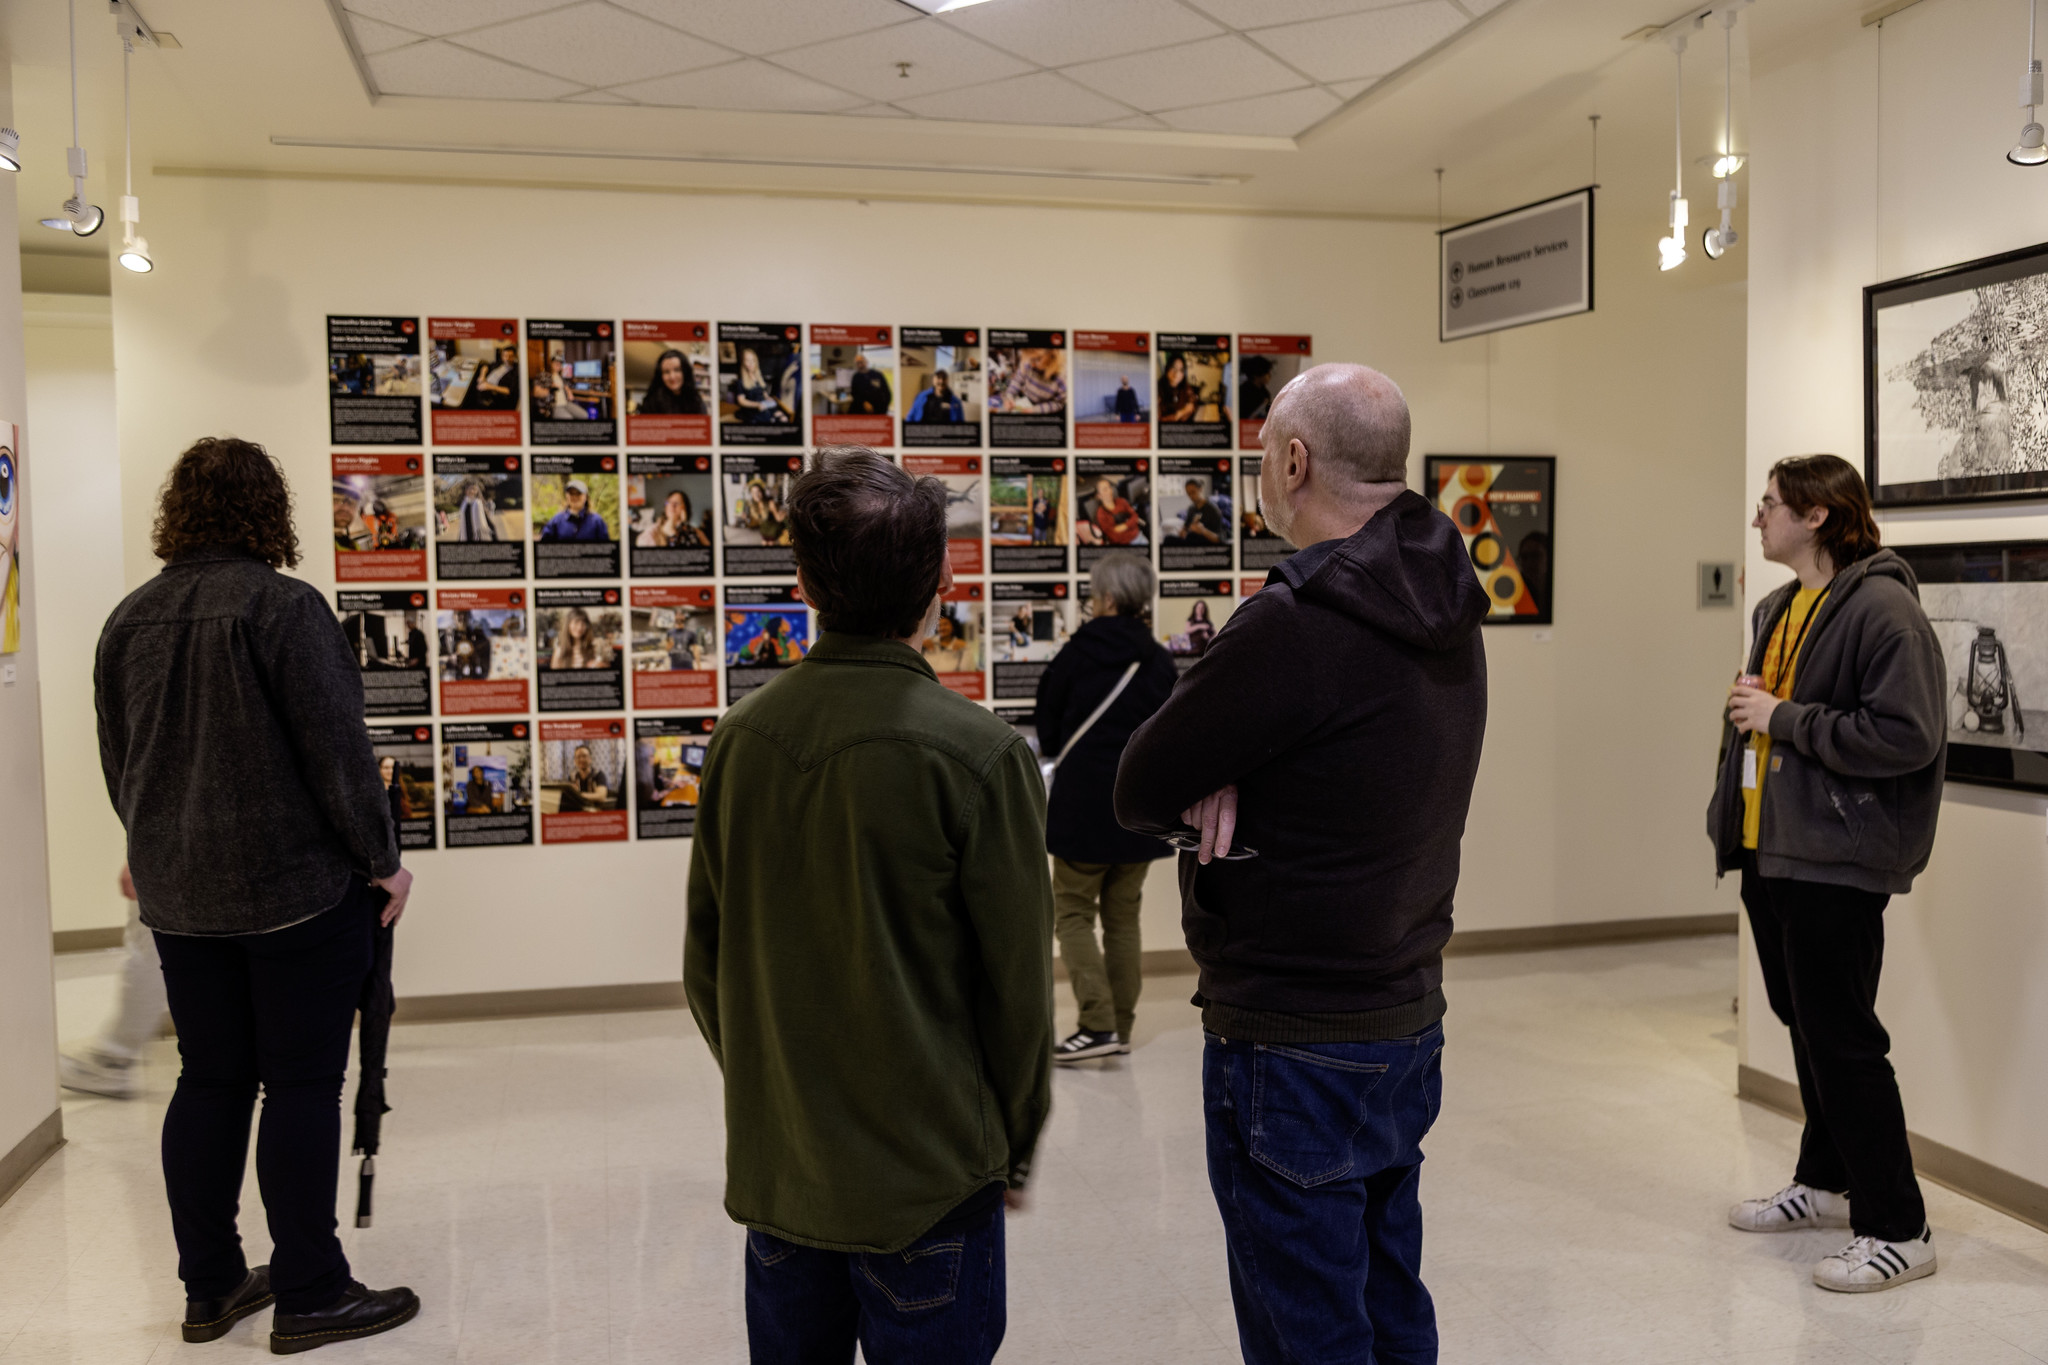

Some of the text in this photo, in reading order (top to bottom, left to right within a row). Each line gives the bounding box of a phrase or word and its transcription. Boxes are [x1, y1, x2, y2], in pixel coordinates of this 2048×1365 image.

[1468, 239, 1568, 274] Human Resource Services
[1468, 282, 1506, 298] Classroom
